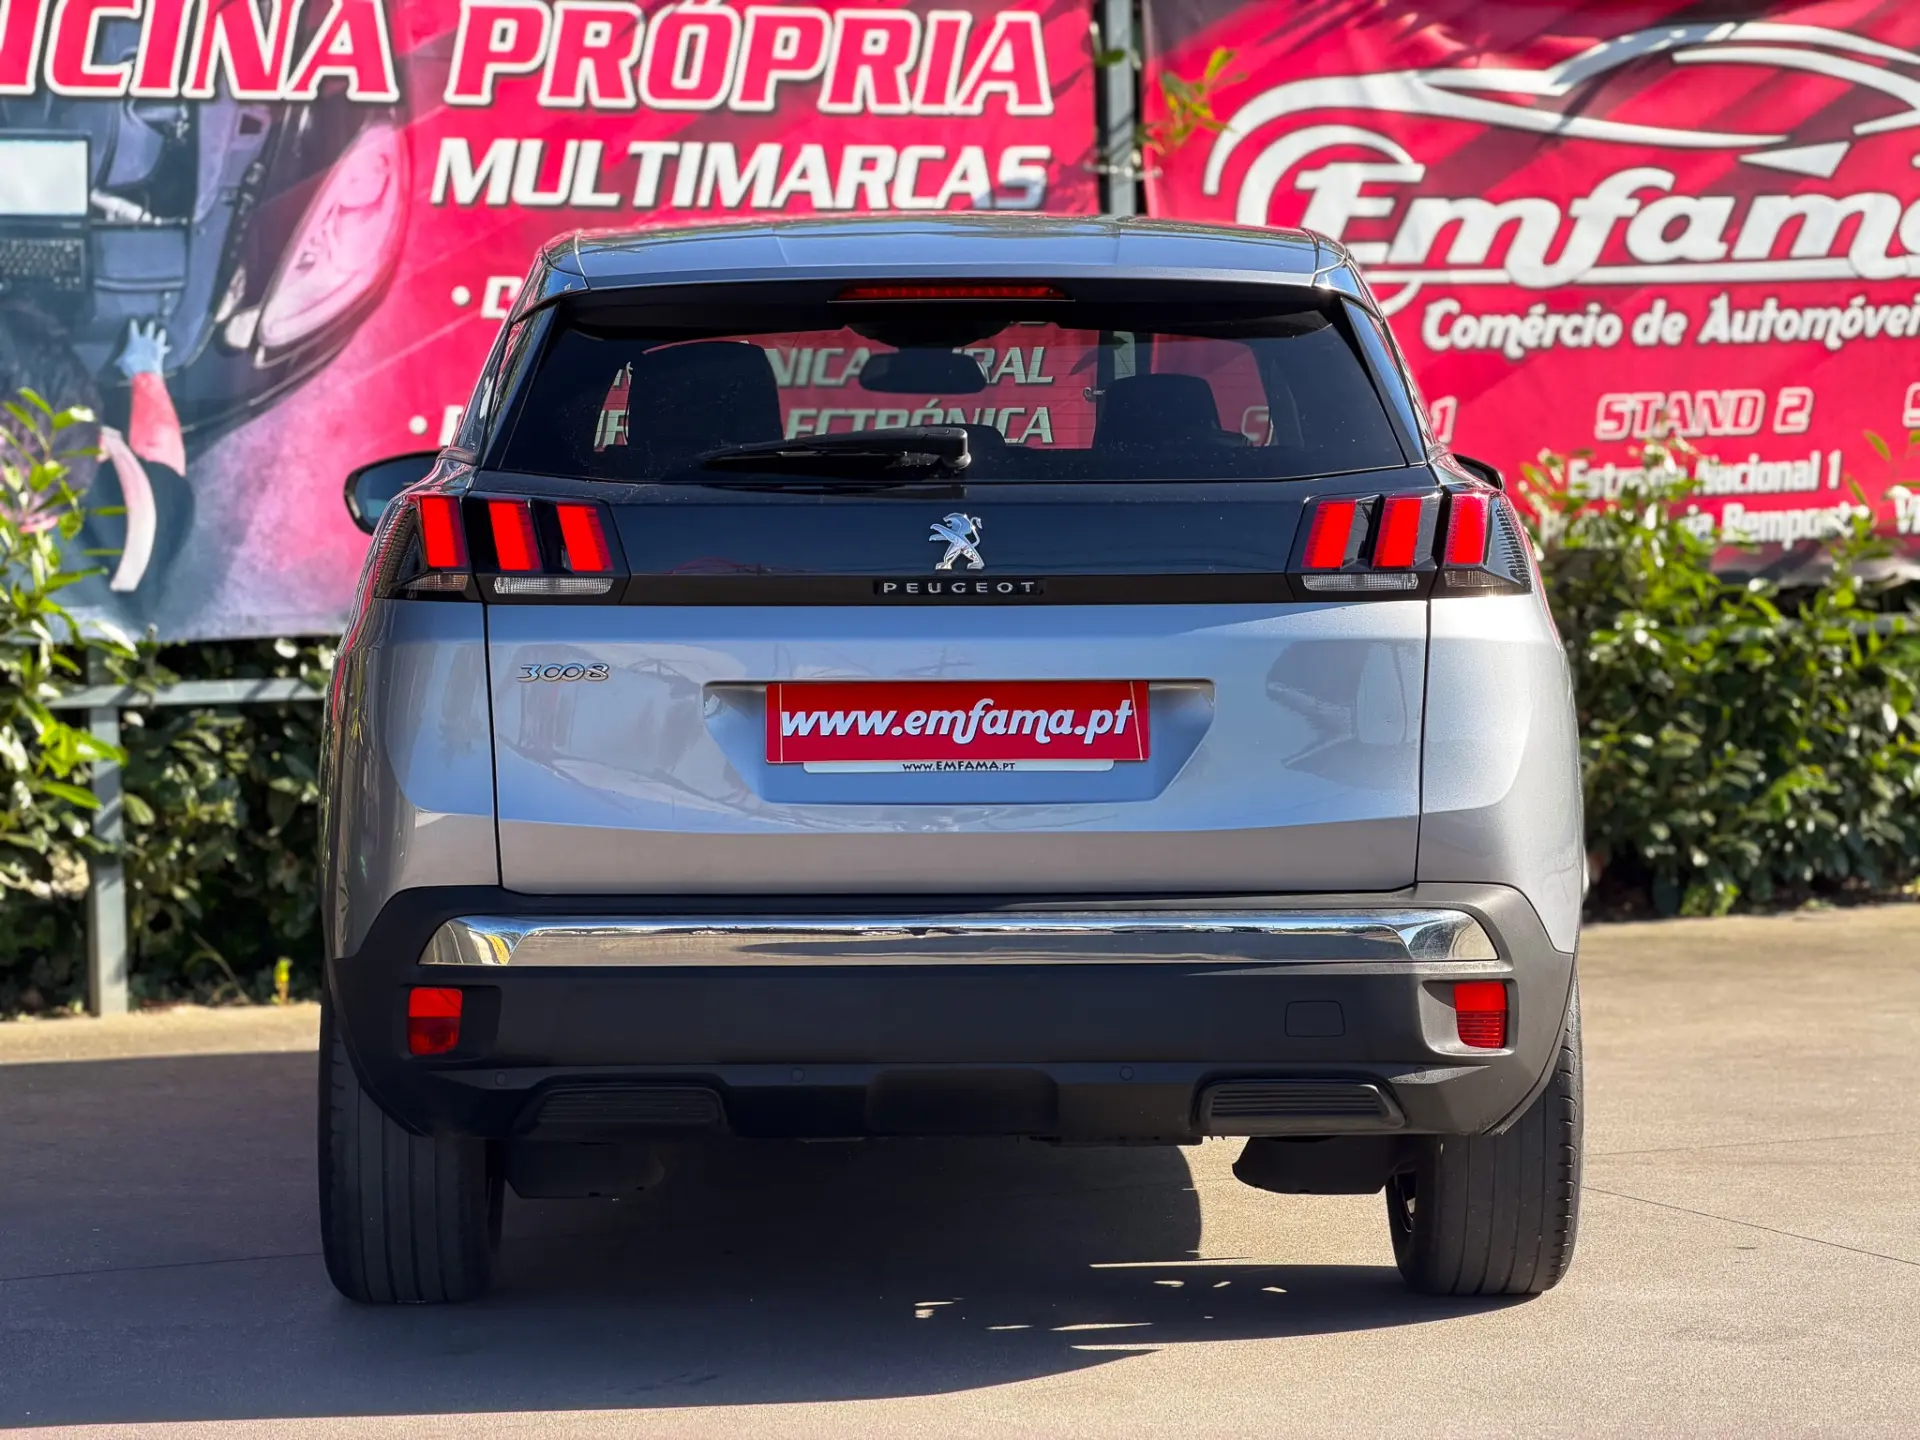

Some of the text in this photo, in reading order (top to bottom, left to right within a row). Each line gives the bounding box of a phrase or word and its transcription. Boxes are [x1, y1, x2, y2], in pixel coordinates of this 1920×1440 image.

[444, 0, 1053, 115] PRÓPRIA
[430, 137, 1051, 211] MULTIMARCAS
[1423, 299, 1622, 359] Comércio
[1632, 299, 1688, 346] de
[1595, 386, 1815, 441] STAND 2
[1693, 449, 1822, 496] Nacional
[1827, 448, 1842, 490] 1
[883, 581, 1035, 594] PEUGEOT
[516, 662, 610, 682] 3008
[779, 697, 1133, 745] www.emfama.pt
